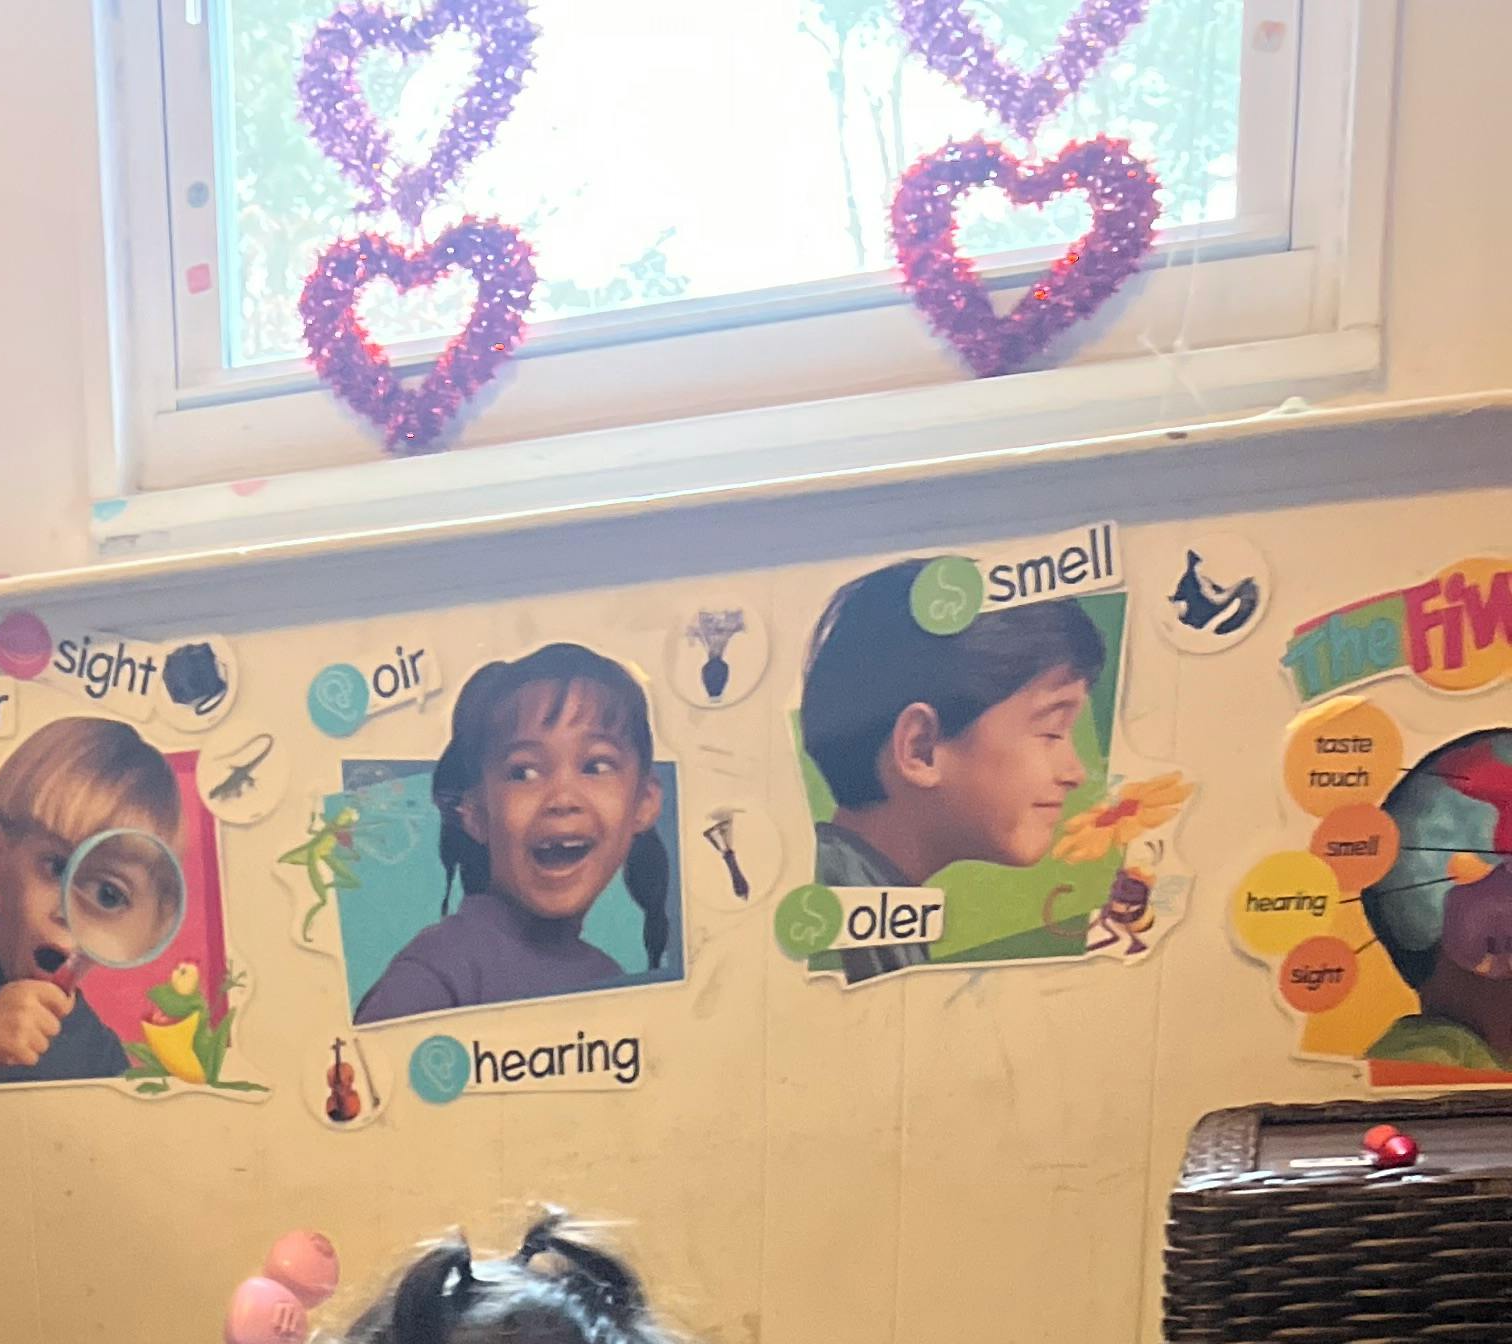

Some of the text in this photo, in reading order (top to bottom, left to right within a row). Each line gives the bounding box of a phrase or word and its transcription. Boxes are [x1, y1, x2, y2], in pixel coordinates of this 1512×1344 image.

[989, 525, 1112, 602] smell
[1280, 572, 1512, 696] The Fiv
[53, 636, 157, 699] sight
[373, 646, 425, 698] oir
[1314, 736, 1372, 754] taste
[1308, 766, 1369, 788] touch
[1326, 835, 1380, 857] smell
[848, 892, 942, 941] oler
[1246, 892, 1328, 917] hearing
[1290, 963, 1345, 991] sight
[472, 1031, 639, 1084] hearing
